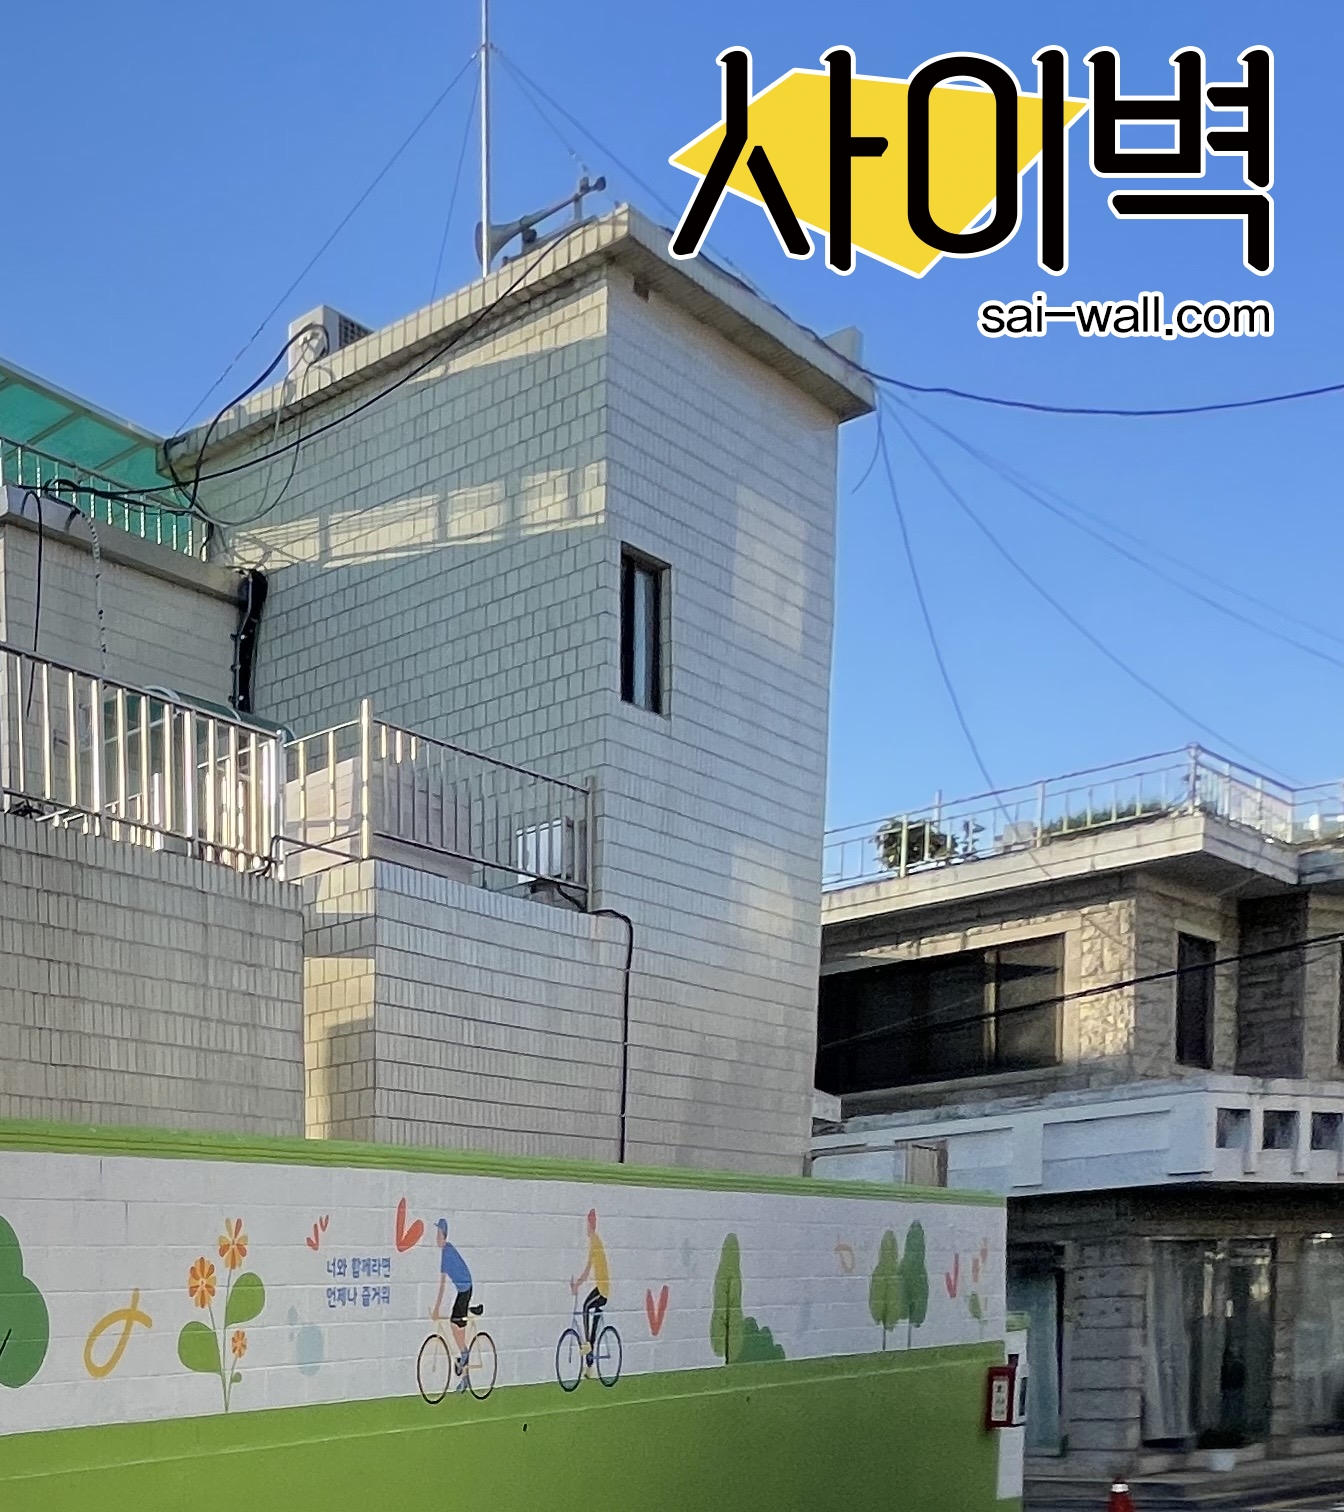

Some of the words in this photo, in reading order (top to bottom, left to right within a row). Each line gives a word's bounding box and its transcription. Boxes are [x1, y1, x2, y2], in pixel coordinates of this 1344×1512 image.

[326, 1256, 348, 1278] 너와
[351, 1256, 391, 1279] 함께라면
[326, 1286, 358, 1308] 언제나
[361, 1285, 391, 1308] 즐거워
